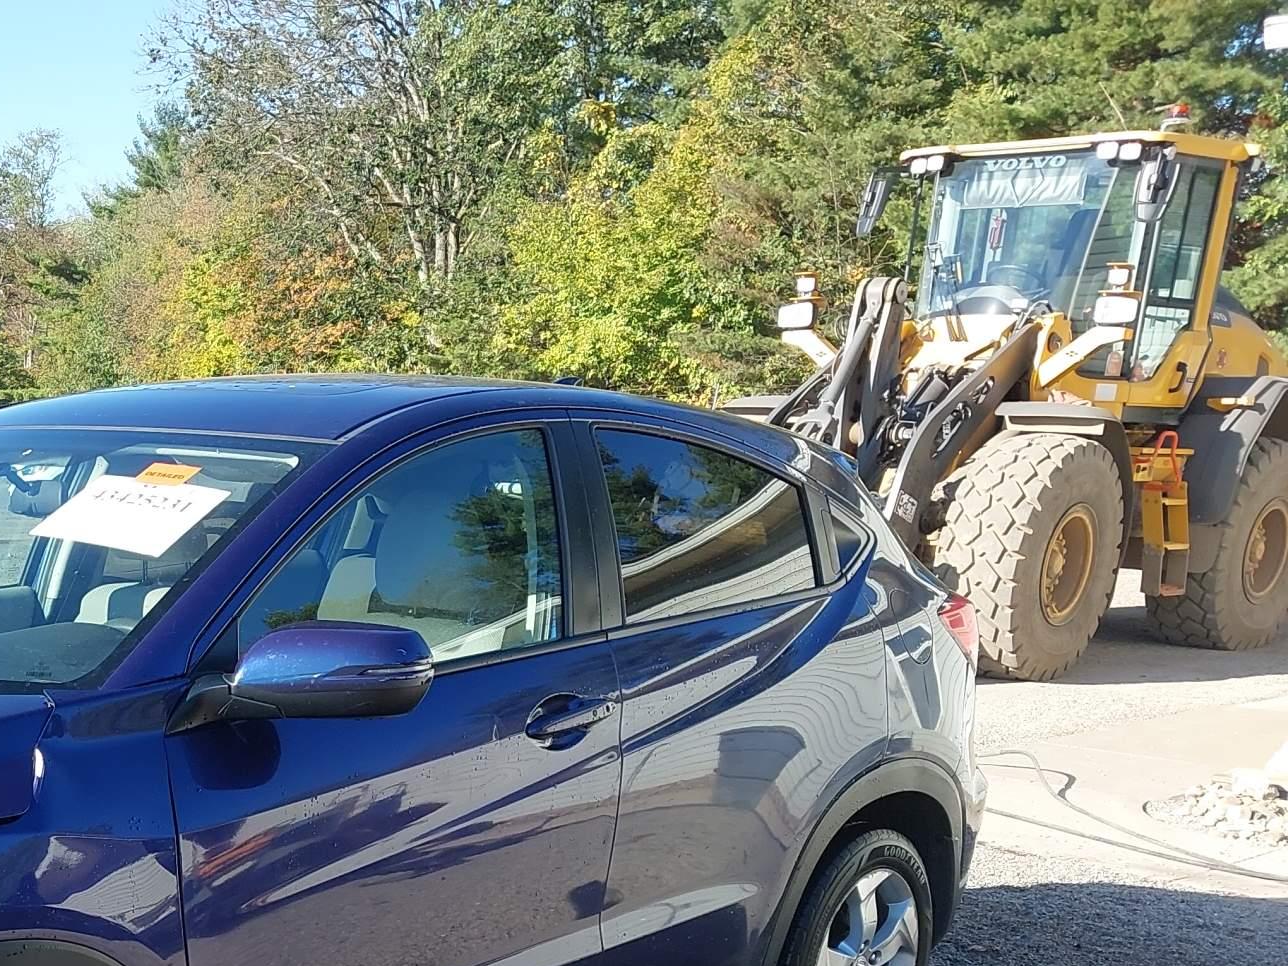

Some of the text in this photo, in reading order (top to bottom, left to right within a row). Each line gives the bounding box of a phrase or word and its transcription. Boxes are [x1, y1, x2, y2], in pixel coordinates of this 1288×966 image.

[984, 155, 1067, 171] VOLVO
[144, 470, 186, 480] DETAILED
[884, 845, 926, 885] GOODYEAR
